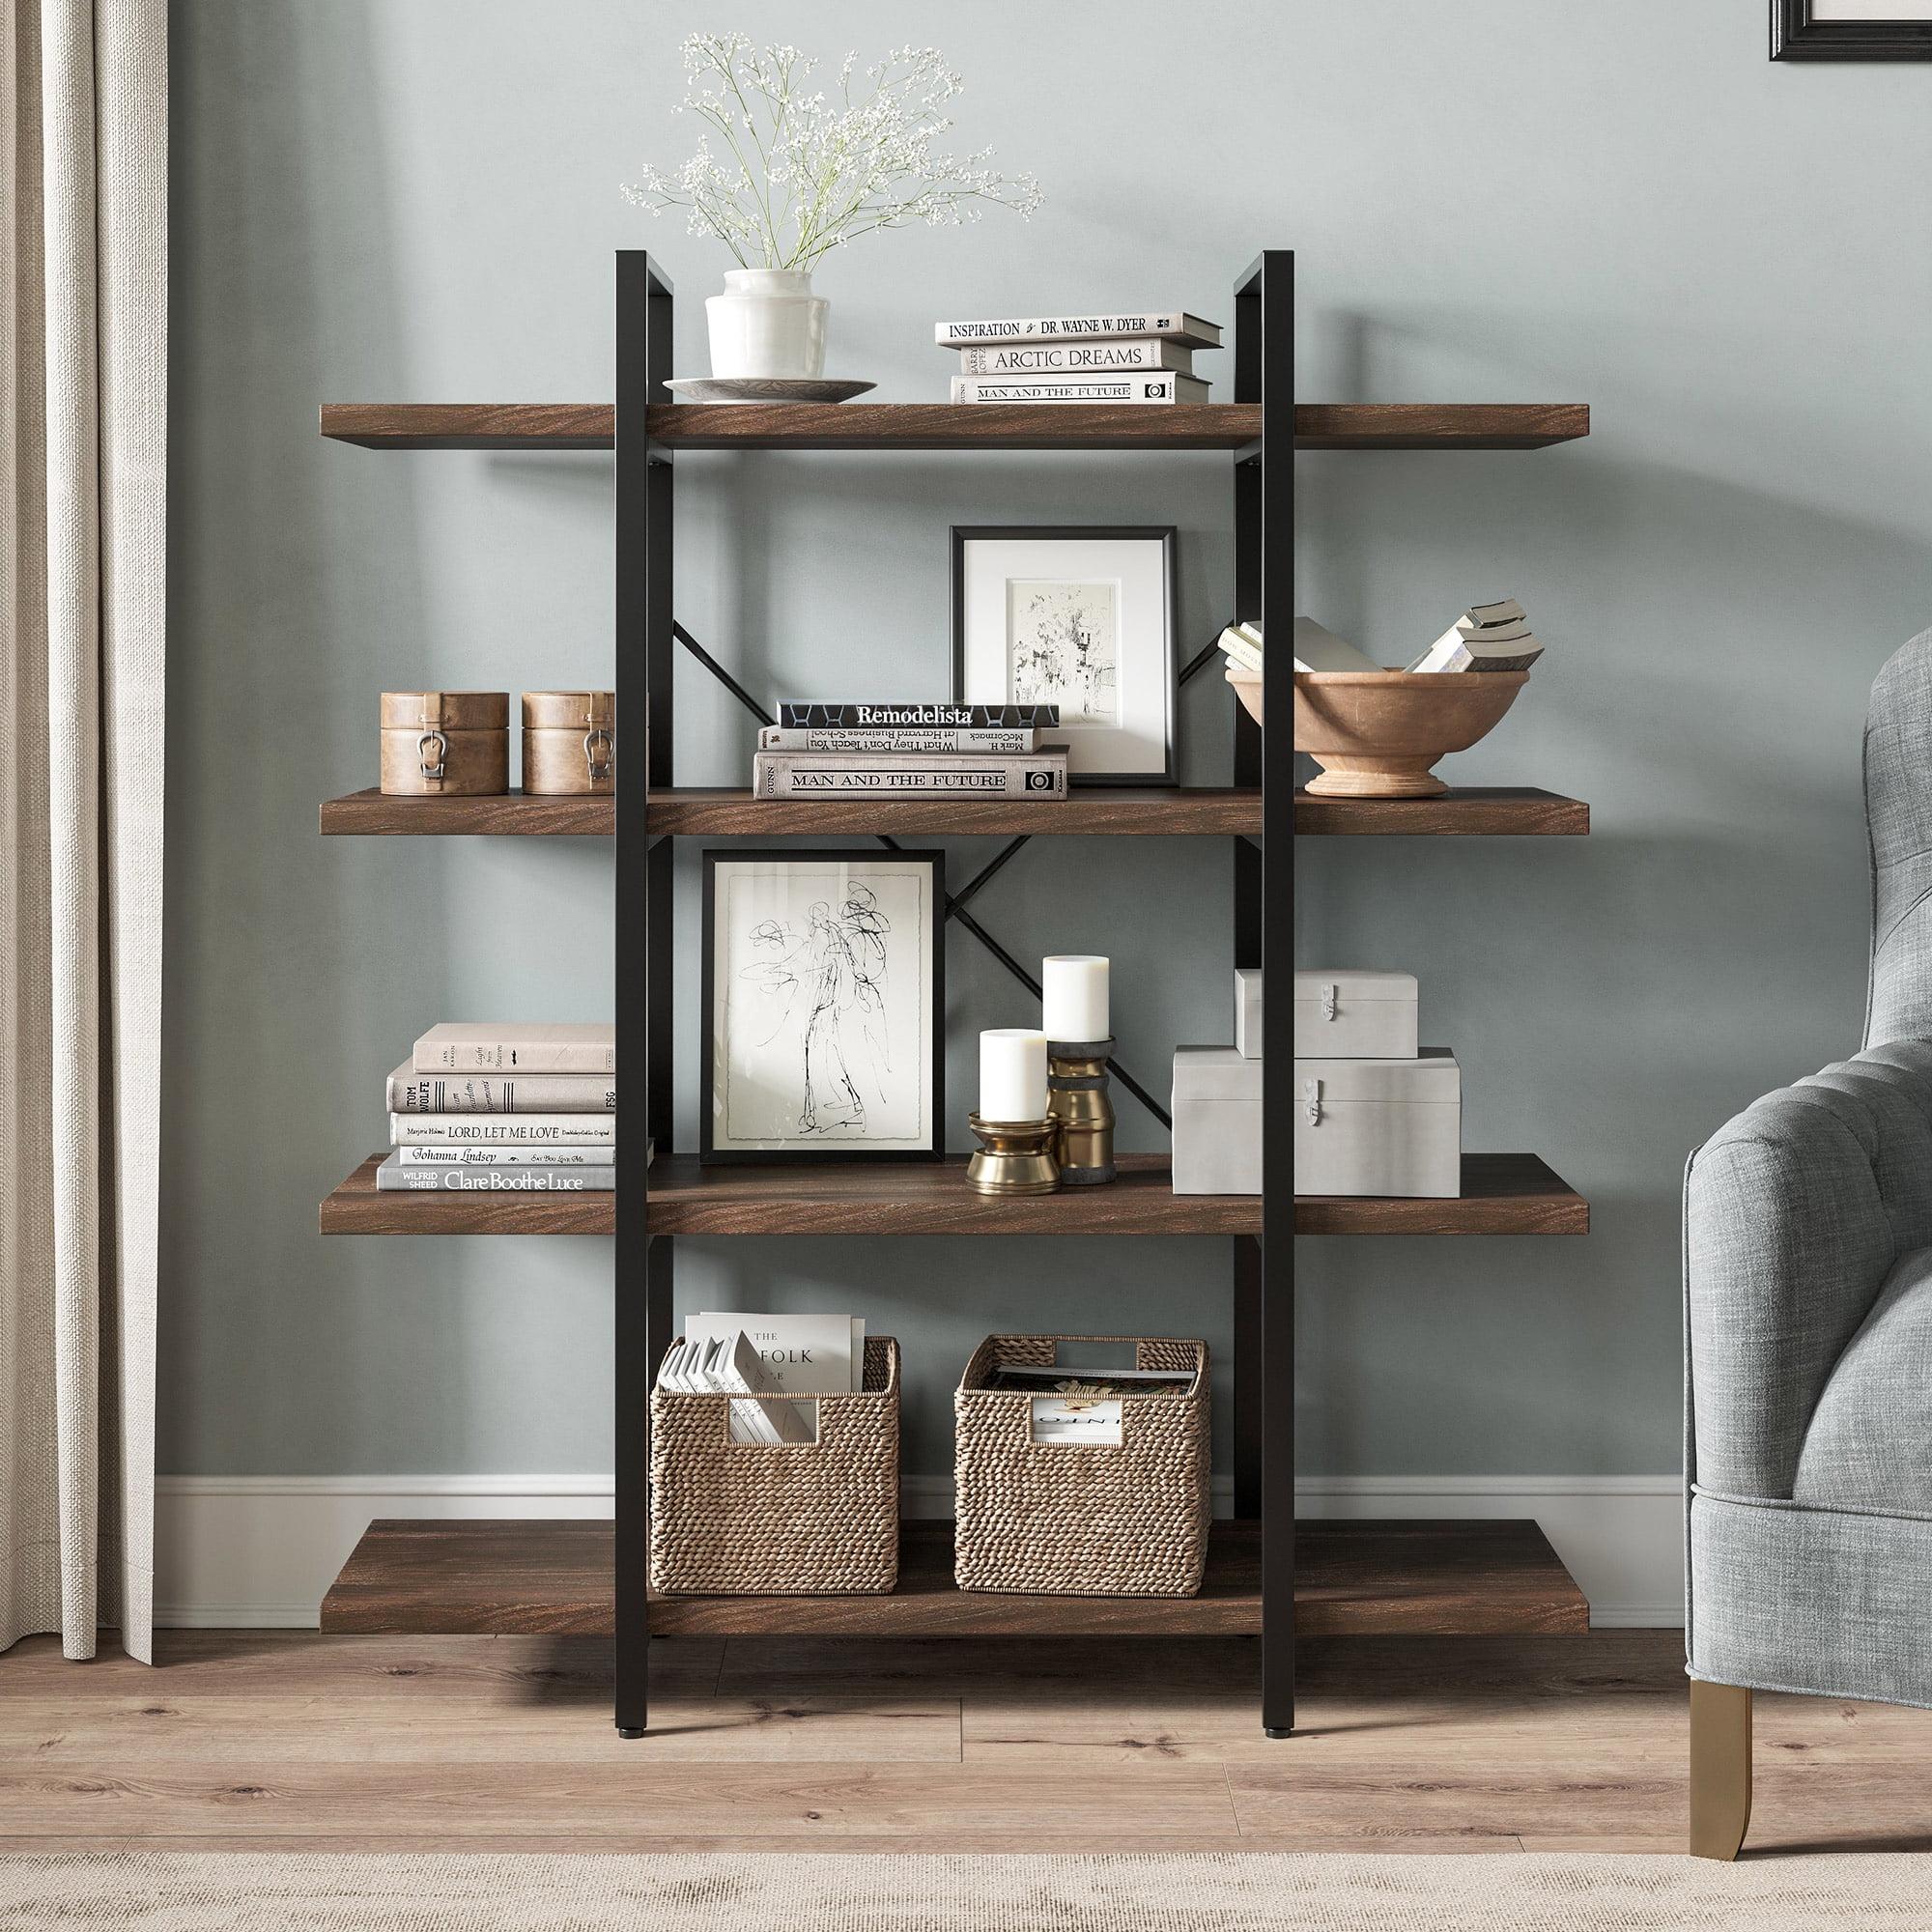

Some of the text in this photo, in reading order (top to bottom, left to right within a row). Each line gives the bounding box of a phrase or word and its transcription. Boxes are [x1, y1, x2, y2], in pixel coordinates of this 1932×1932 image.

[950, 323, 1020, 337] INSPIRATION
[1040, 320, 1060, 334] DR.
[1062, 319, 1101, 333] WAYNE
[1102, 318, 1115, 332] W.
[1117, 317, 1147, 331] DYER
[995, 351, 1062, 368] ARCTIC
[1068, 348, 1142, 367] DREAMS
[977, 384, 1131, 398] MAN AND THE FUTURE
[857, 706, 973, 724] Remodelista
[904, 728, 942, 739] Harvard
[969, 731, 1023, 742] McCormack
[810, 738, 955, 753] What They Don't Teach You
[988, 741, 1023, 751] Mark H.
[792, 774, 1006, 786] MAN AND THE FUTURE
[406, 1087, 417, 1107] TOM
[419, 1081, 430, 1112] WOLFE
[447, 1126, 483, 1140] LORD,
[485, 1126, 508, 1139] LET
[509, 1126, 527, 1139] ME
[529, 1126, 560, 1139] LOVE
[412, 1148, 457, 1161] Johanna
[460, 1148, 497, 1165] Lindsey
[403, 1172, 438, 1180] WILFRID
[444, 1171, 583, 1190] Clare Boothe Luce
[754, 1332, 777, 1342] THE
